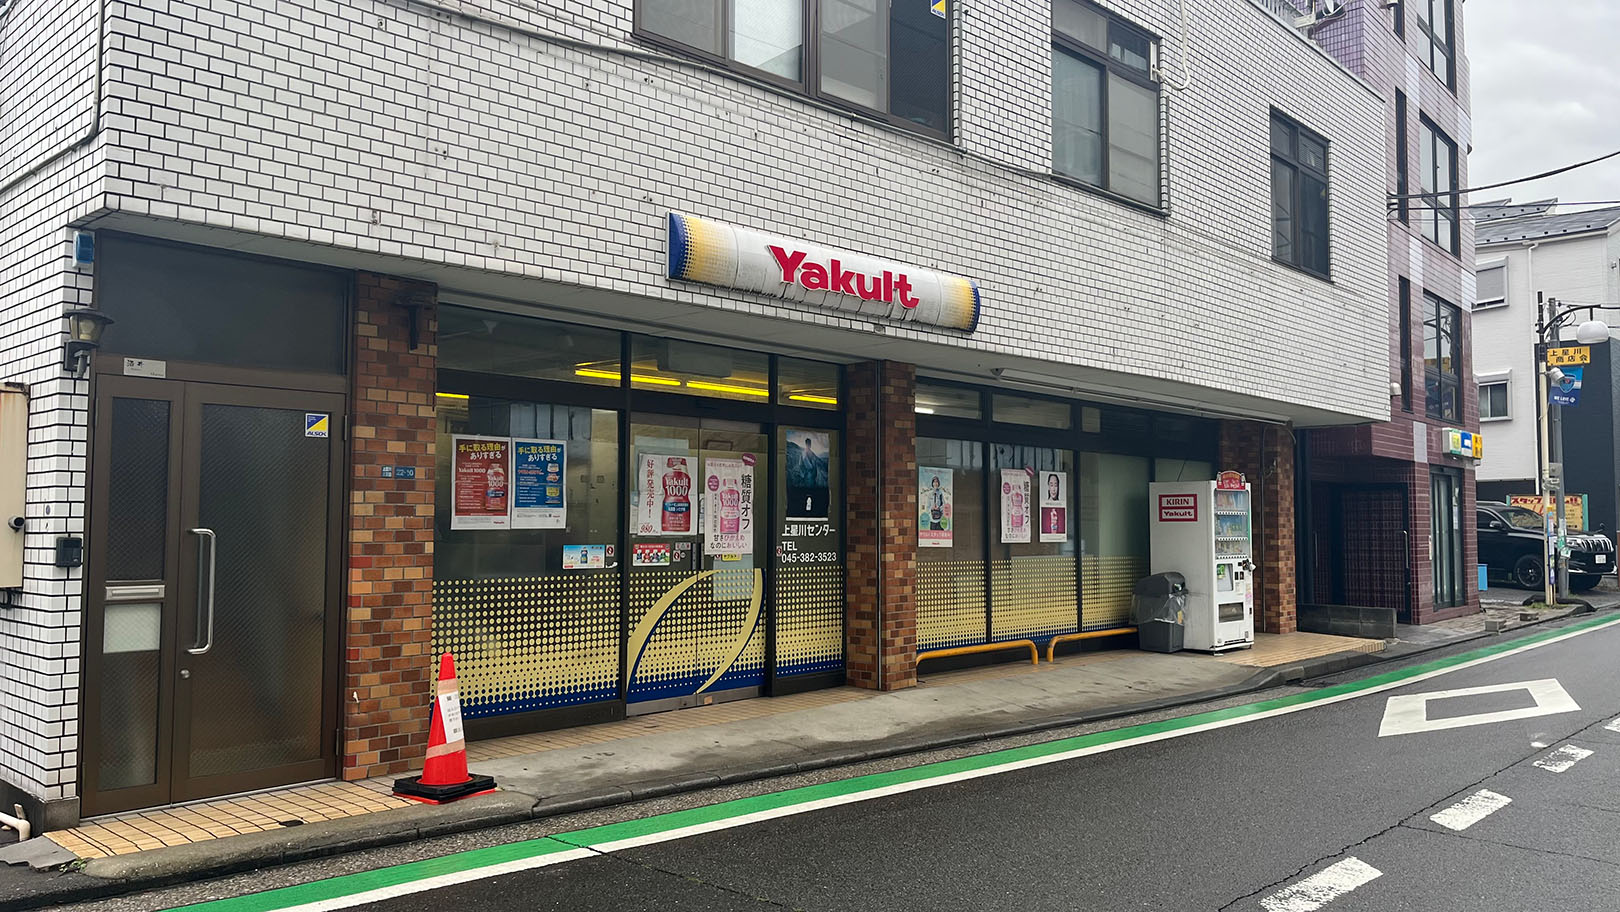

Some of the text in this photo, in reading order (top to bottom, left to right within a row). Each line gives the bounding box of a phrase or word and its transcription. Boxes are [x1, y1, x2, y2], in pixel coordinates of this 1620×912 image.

[768, 244, 920, 309] Yakult
[1550, 348, 1582, 356] 上星川
[1556, 354, 1588, 363] 商店会
[459, 443, 505, 453] 手に取る理由が
[518, 445, 561, 455] 手に取る理由が
[470, 451, 502, 460] ありすぎる
[528, 453, 557, 462] ありすぎる
[665, 477, 689, 486] Yakult
[666, 486, 689, 497] 1000
[741, 473, 752, 529] 糖質オフ
[781, 524, 836, 536] 上星川センター
[782, 541, 798, 551] TEL
[781, 552, 837, 563] 045-382-3523
